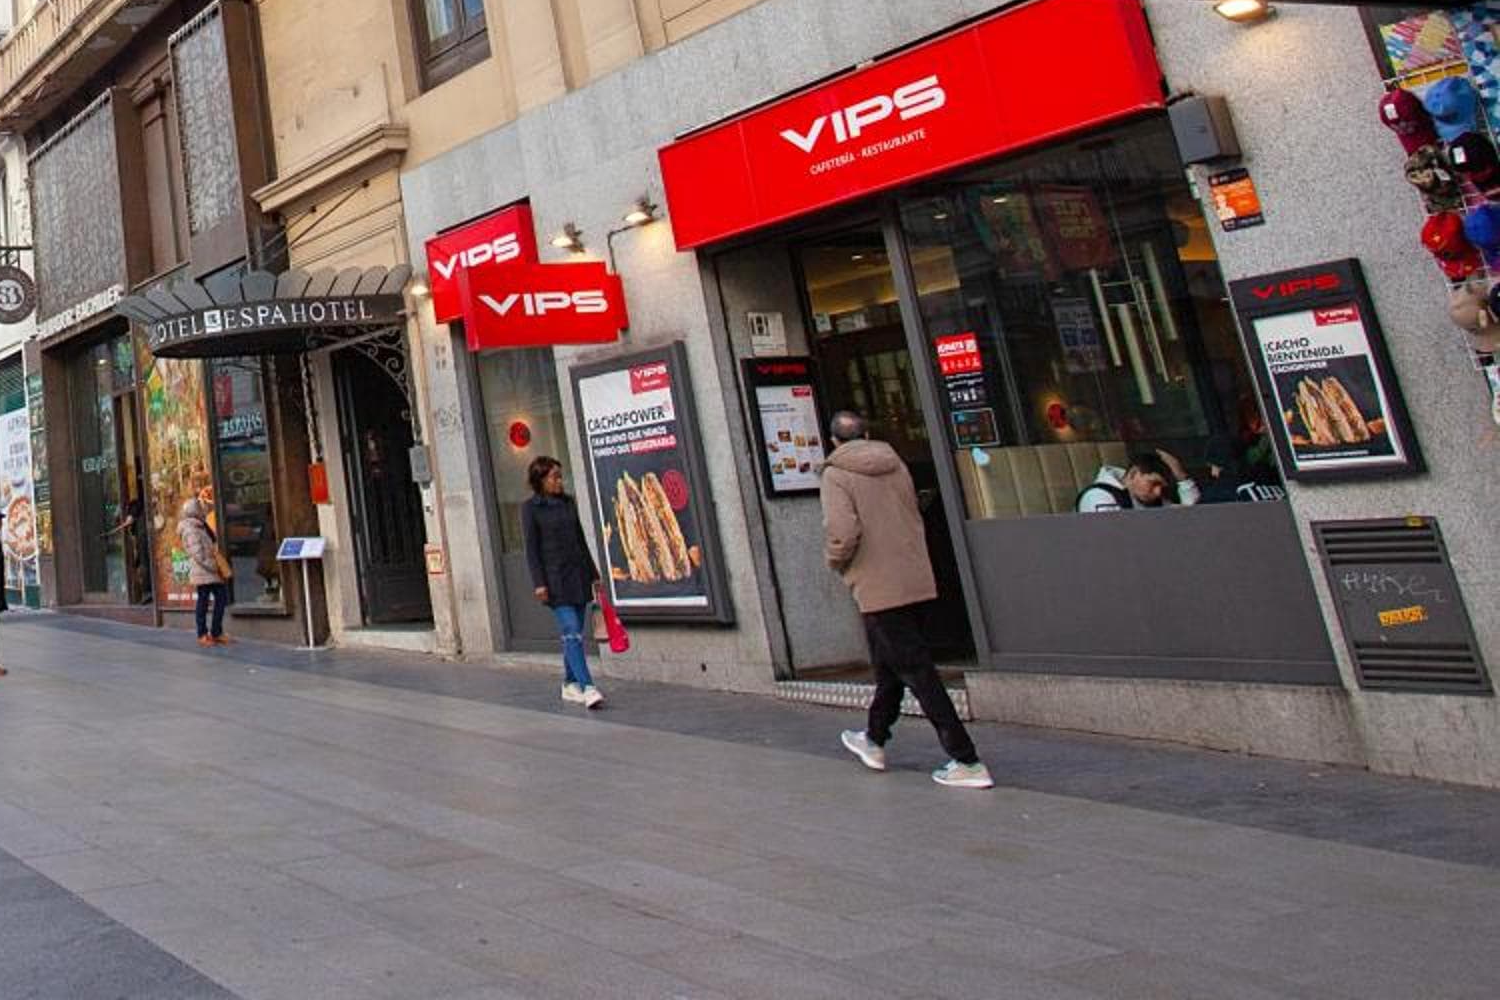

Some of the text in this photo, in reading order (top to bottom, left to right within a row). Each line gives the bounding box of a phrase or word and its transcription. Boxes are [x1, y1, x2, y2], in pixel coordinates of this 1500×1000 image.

[779, 74, 946, 153] VIPS
[861, 127, 926, 158] RESTAURANTE
[433, 232, 520, 279] VIPS
[1252, 272, 1341, 299] VIPS
[479, 290, 608, 317] VIPS
[1267, 345, 1345, 363] BIENVENIDA!
[633, 365, 667, 379] VIPS
[588, 405, 665, 432] CACHOPOWER
